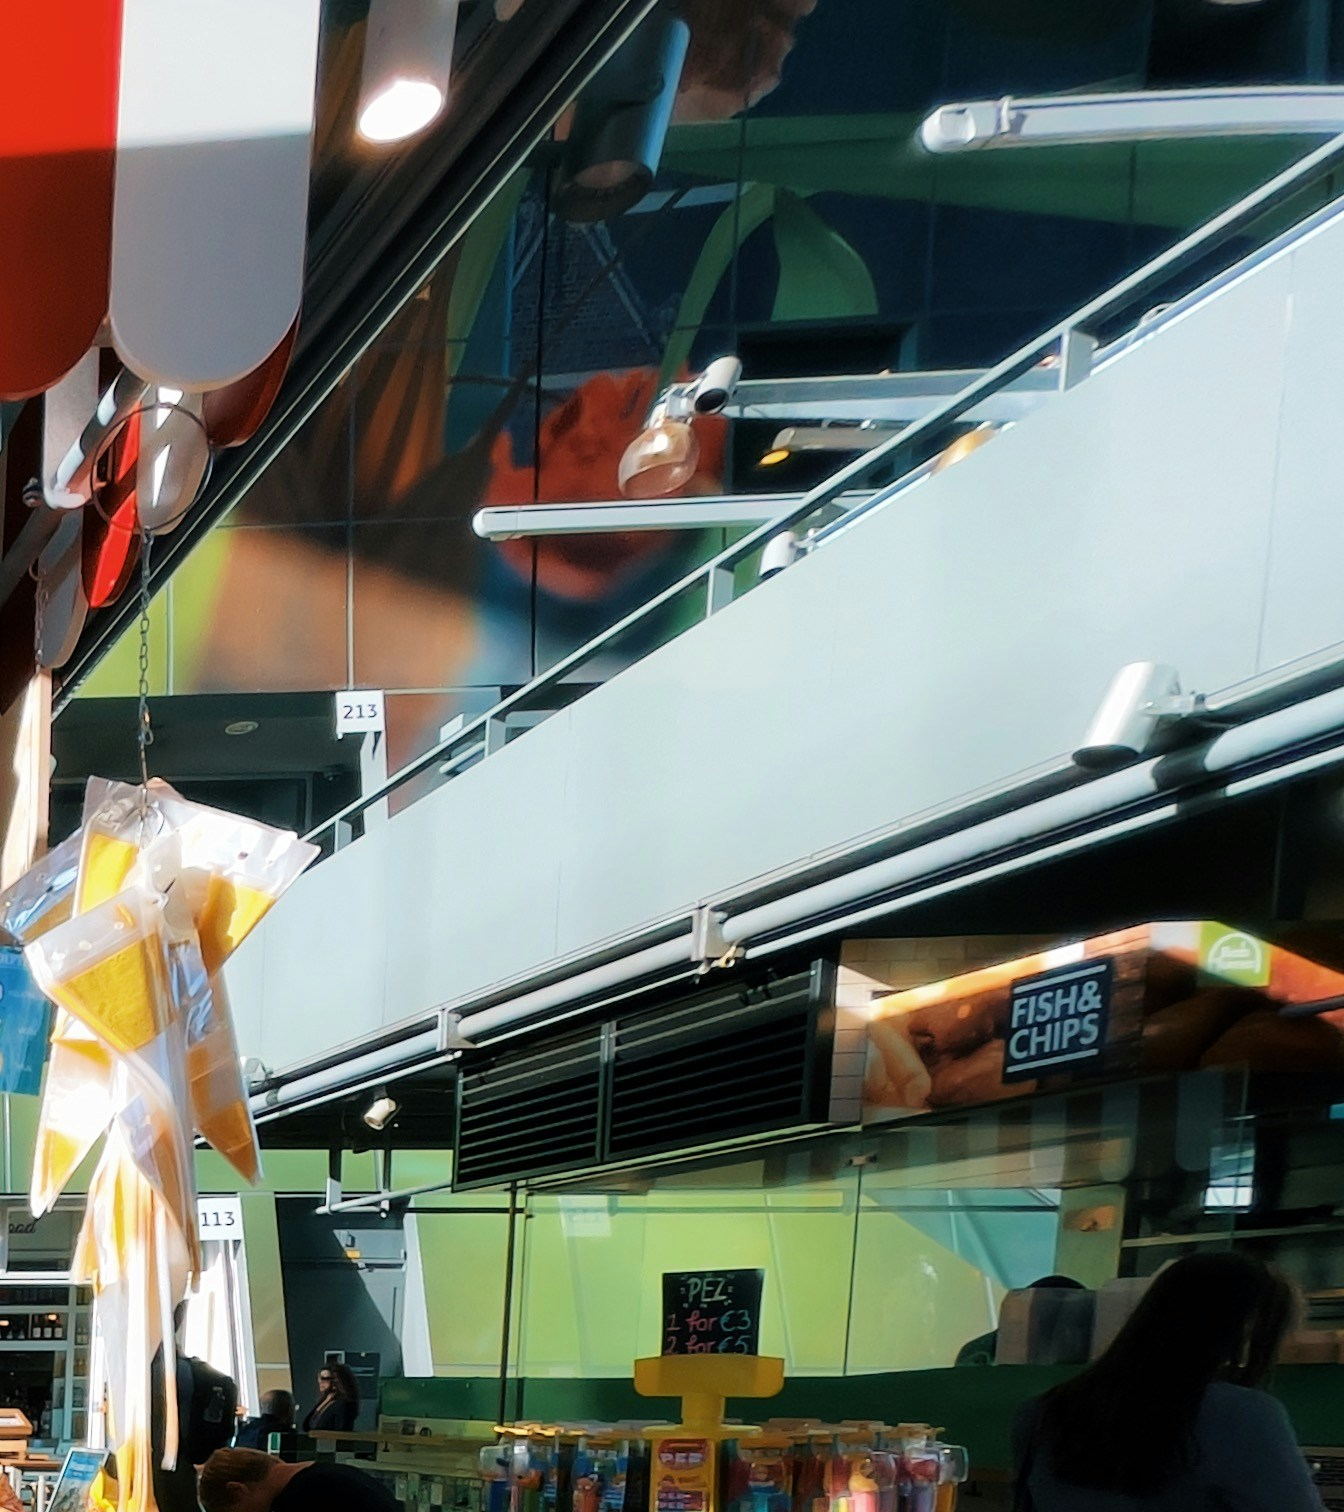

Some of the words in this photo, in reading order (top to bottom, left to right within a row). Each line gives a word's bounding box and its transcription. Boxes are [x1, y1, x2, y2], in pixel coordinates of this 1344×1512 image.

[343, 704, 378, 720] 213
[1011, 980, 1102, 1028] FISH&
[1009, 1013, 1099, 1060] CHIPS
[201, 1210, 236, 1228] 113
[687, 1277, 728, 1303] PEZ
[666, 1313, 682, 1332] 1
[686, 1310, 719, 1332] for
[720, 1309, 752, 1332] €3
[685, 1335, 717, 1354] for
